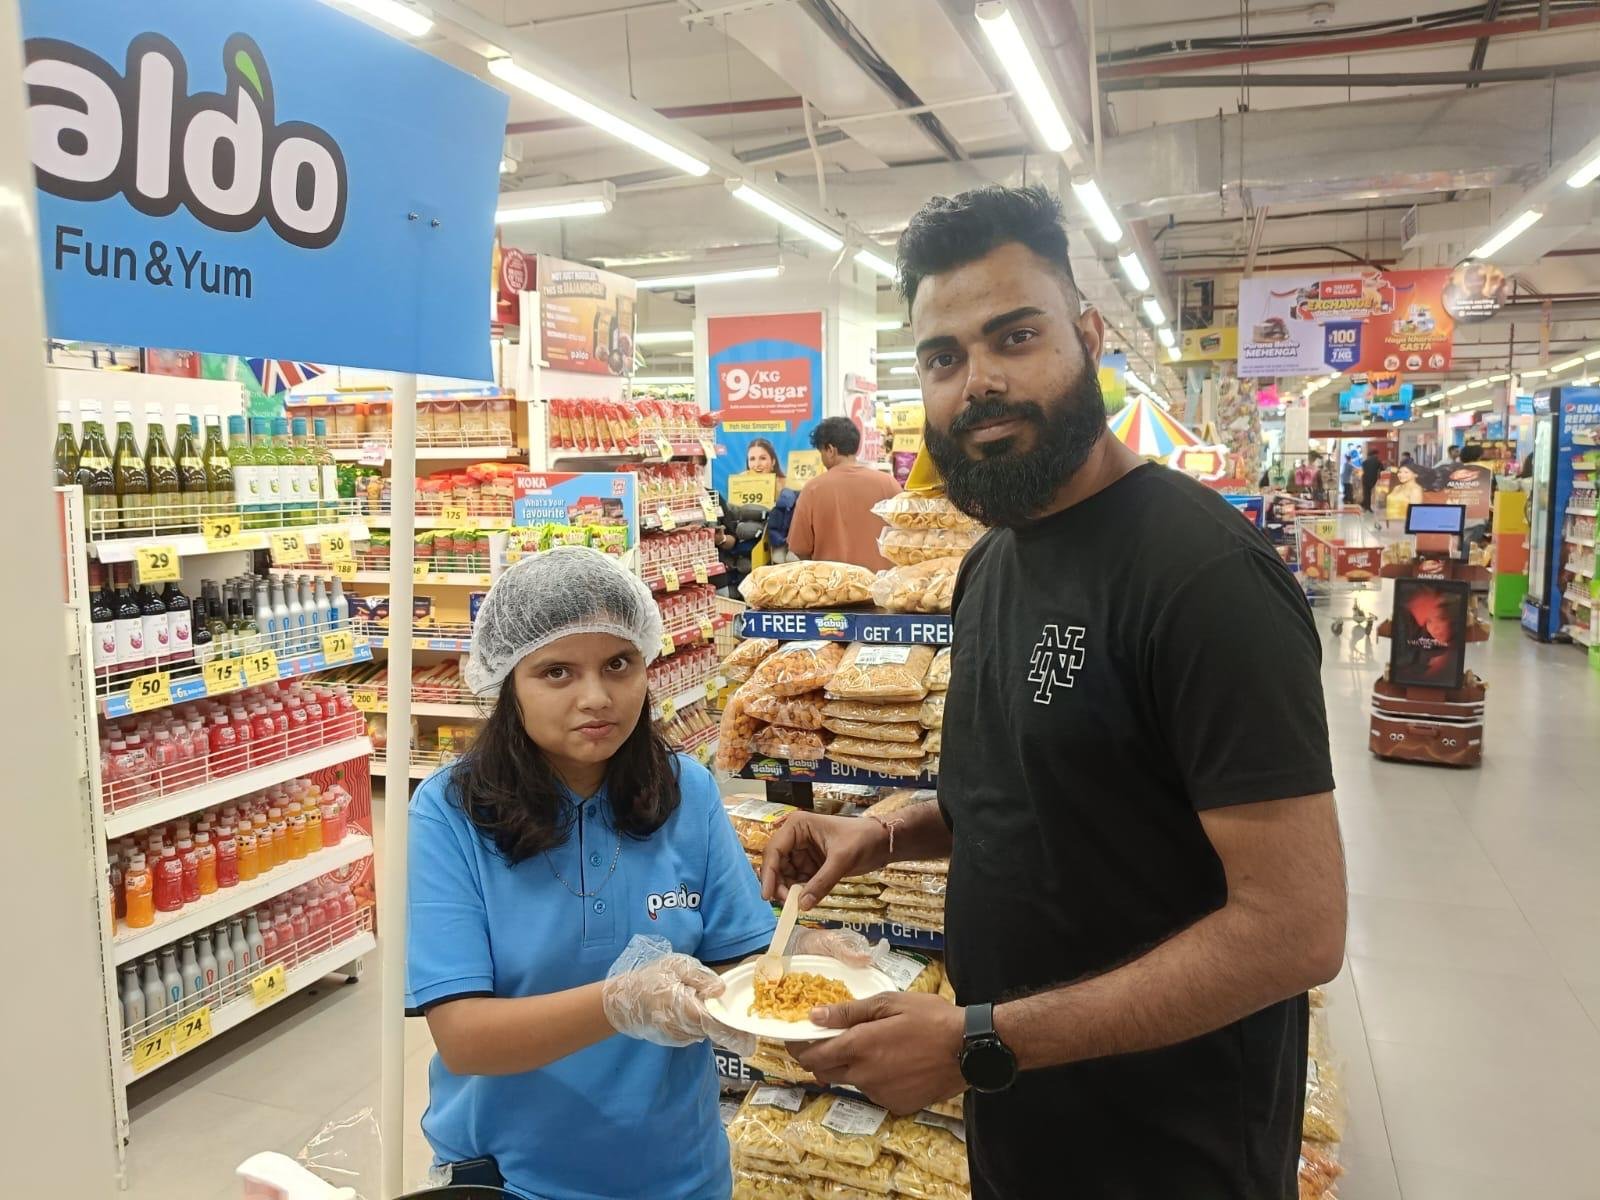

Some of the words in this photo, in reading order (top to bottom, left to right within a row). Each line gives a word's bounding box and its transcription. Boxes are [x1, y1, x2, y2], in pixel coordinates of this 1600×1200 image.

[748, 383, 808, 403] Sugar
[517, 476, 547, 489] KOKA
[446, 511, 461, 520] 175
[762, 615, 806, 633] FREE
[814, 617, 849, 632] Babuji
[863, 627, 891, 641] GET
[895, 627, 903, 642] 1
[356, 695, 372, 703] 200
[750, 764, 783, 775] Babuji
[831, 762, 859, 777] BUY
[891, 922, 920, 939] GET
